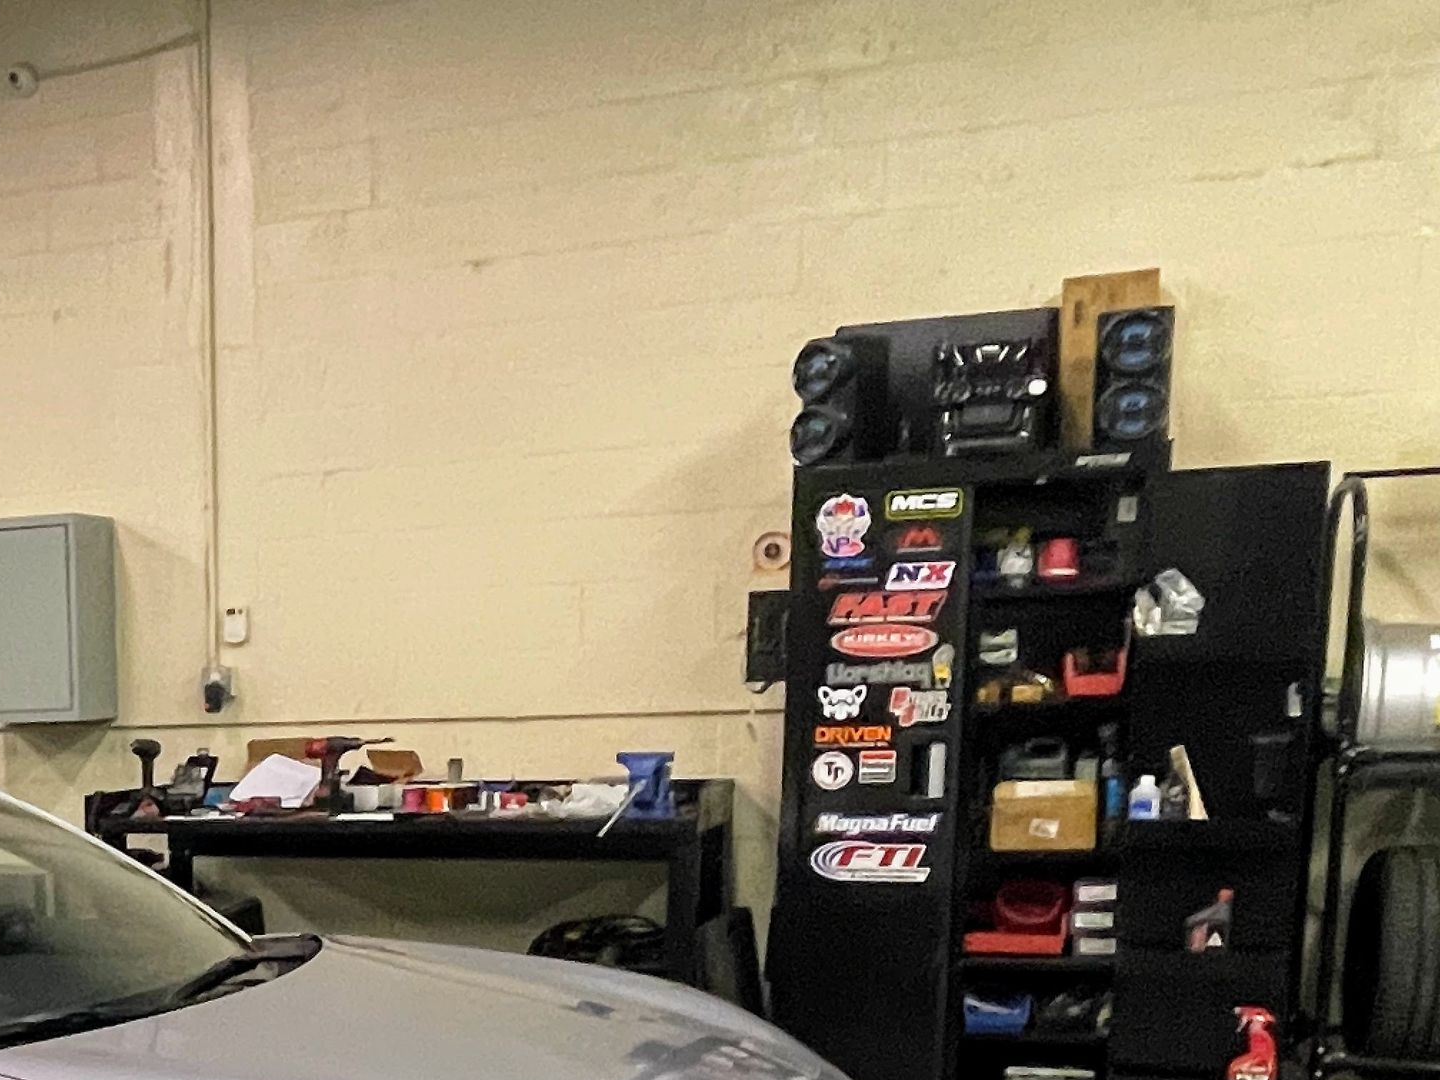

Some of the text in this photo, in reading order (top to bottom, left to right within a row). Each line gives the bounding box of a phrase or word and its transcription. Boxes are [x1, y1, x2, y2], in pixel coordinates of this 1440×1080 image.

[891, 493, 958, 511] MCS
[891, 564, 950, 582] NX
[815, 725, 892, 745] DRIVEN
[816, 813, 938, 835] MagnaFuel
[837, 846, 922, 867] FTI
